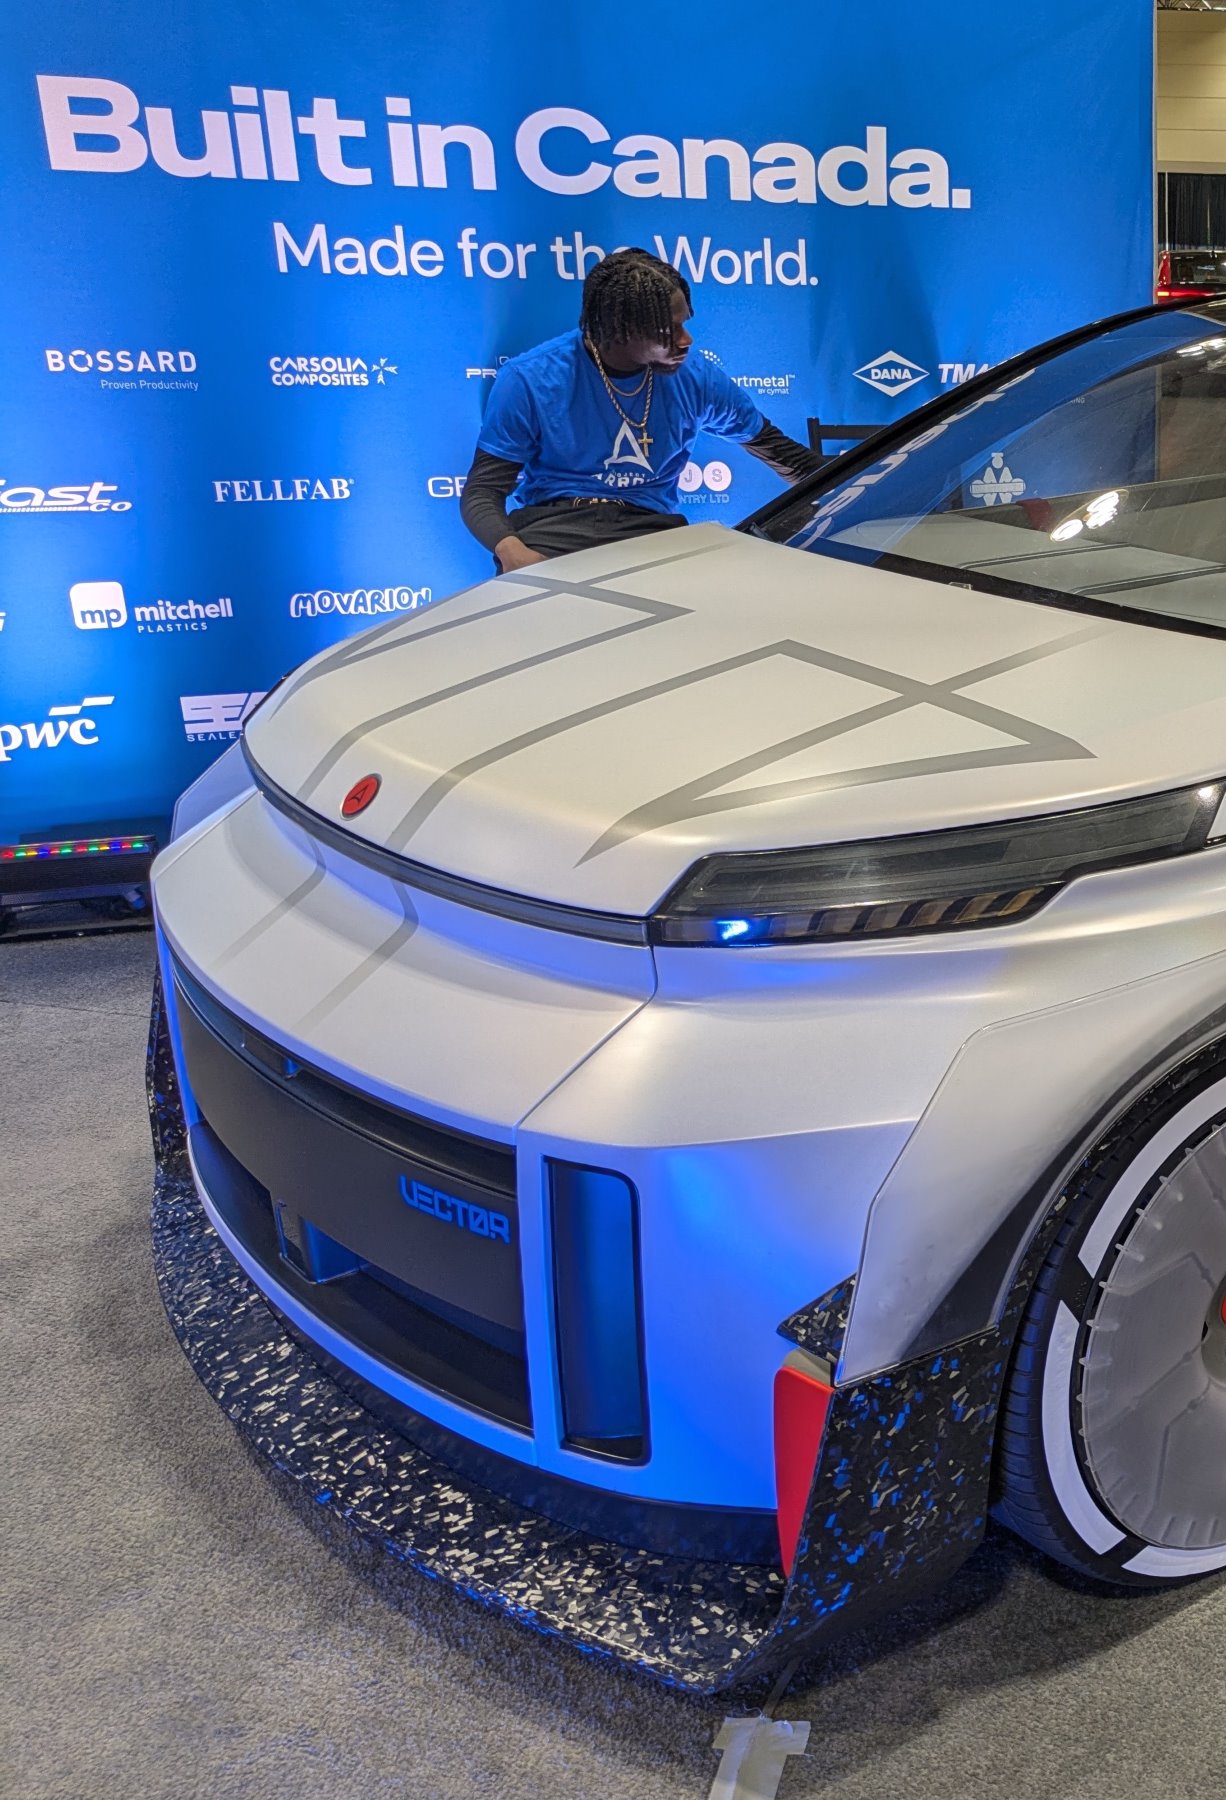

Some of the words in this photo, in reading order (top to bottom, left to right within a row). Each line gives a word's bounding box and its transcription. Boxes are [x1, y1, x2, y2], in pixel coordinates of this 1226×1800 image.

[36, 74, 373, 186] Built
[385, 97, 497, 191] in
[515, 107, 971, 209] Canada.
[273, 221, 444, 278] Made
[457, 227, 536, 280] for
[550, 231, 632, 281] th
[654, 234, 819, 287] World.
[45, 350, 197, 372] BOSSARD
[269, 357, 368, 373] CARSOLIA
[101, 379, 137, 389] Proven
[139, 379, 199, 391] Productivity
[271, 373, 370, 386] COMPOSITES
[870, 368, 912, 380] DANA
[0, 480, 118, 507] ast
[211, 479, 351, 502] FELLFAB
[709, 493, 730, 504] LTD
[134, 598, 234, 622] mitchell
[290, 586, 432, 618] MOVARION
[80, 608, 122, 629] mp
[137, 622, 208, 633] PLASTICS
[0, 718, 99, 762] pwc
[399, 1174, 511, 1245] VECTOR
